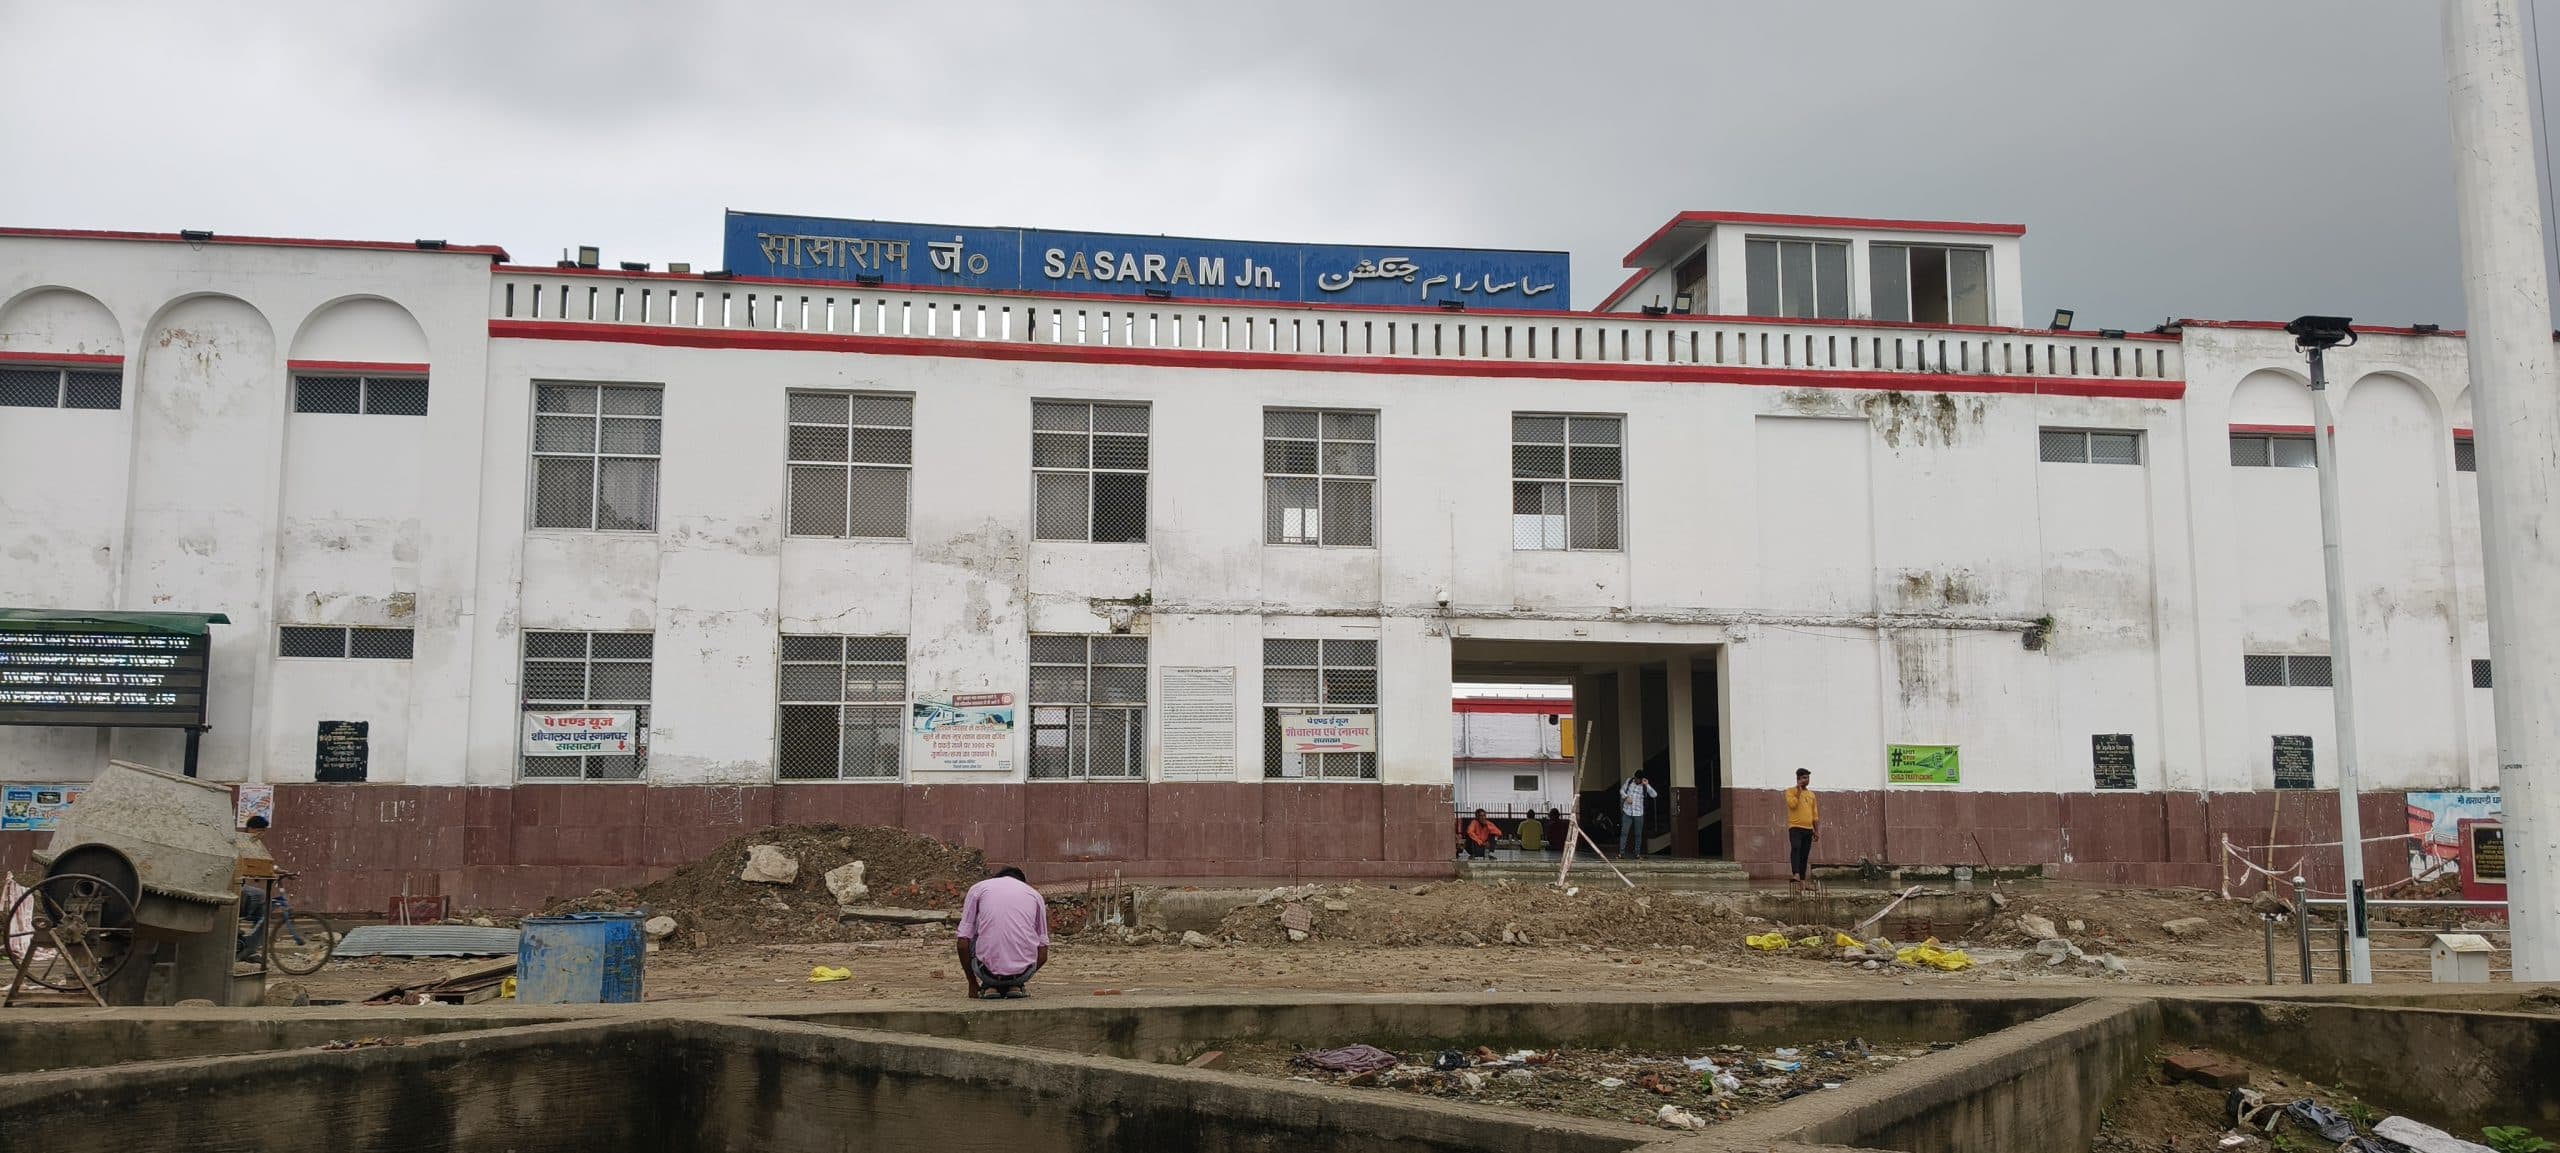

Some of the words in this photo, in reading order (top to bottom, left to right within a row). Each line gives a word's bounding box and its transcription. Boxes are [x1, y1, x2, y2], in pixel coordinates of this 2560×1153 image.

[757, 232, 910, 272] सासाराम
[1043, 248, 1225, 286] SASARAM
[1235, 258, 1281, 289] Jn.
